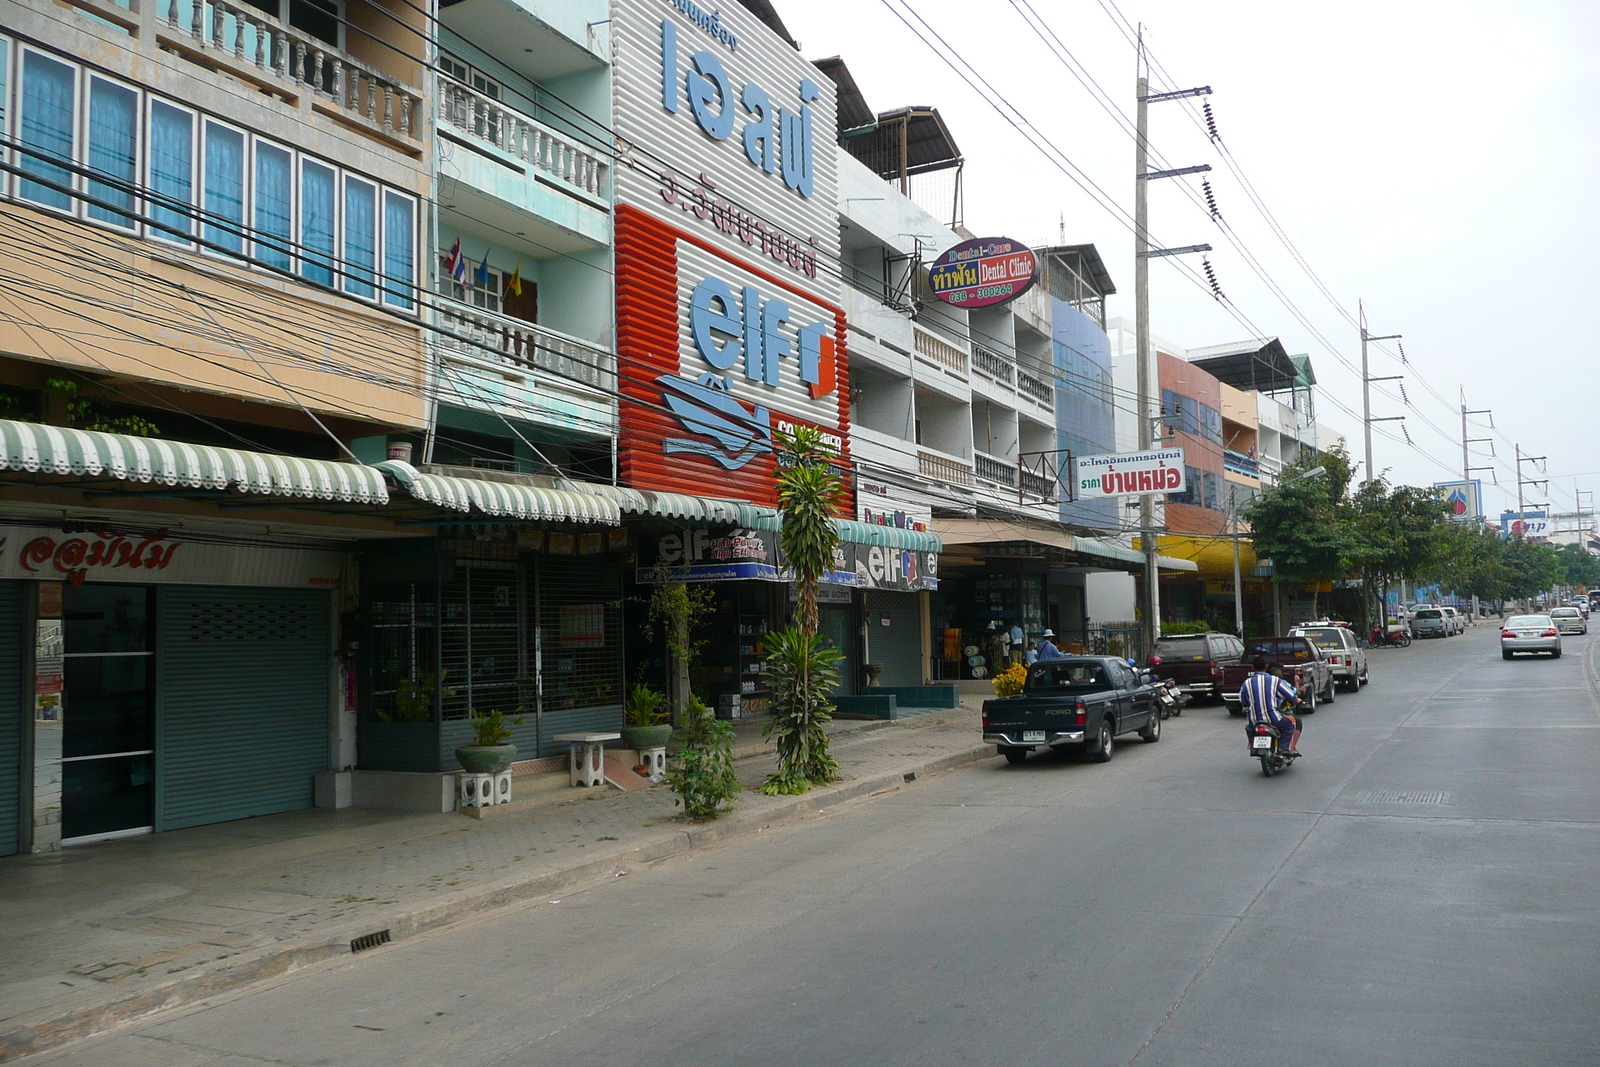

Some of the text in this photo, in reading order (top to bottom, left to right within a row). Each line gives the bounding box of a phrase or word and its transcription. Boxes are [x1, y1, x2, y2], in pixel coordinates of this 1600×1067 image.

[933, 263, 977, 290] ทำฟัน
[981, 256, 1032, 281] Dental Clinic
[949, 291, 967, 303] 038
[978, 284, 1012, 299] 300264
[690, 276, 790, 388] elf
[1101, 460, 1181, 494] บ้านหม้อ
[659, 529, 710, 562] elf
[869, 546, 901, 582] elf
